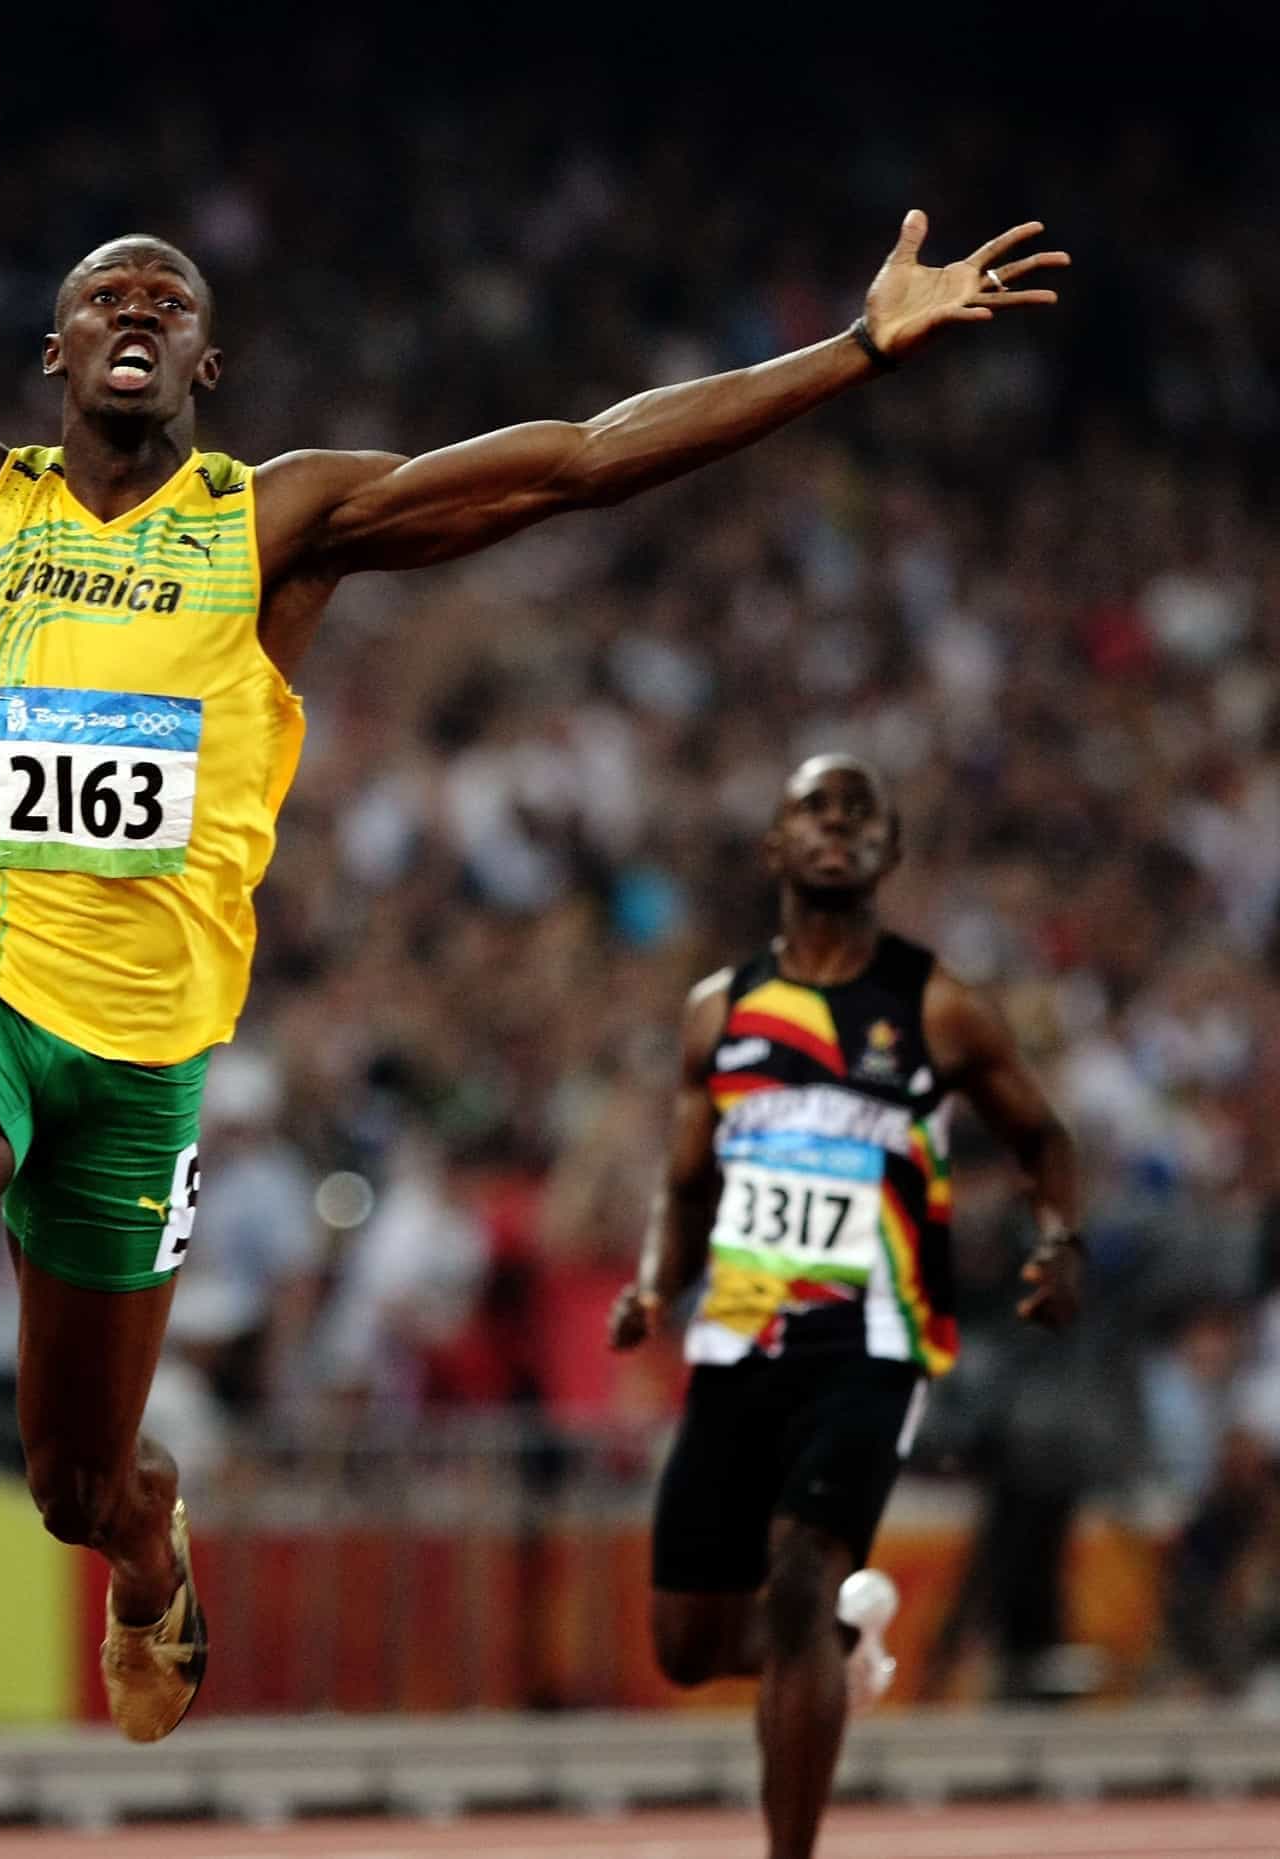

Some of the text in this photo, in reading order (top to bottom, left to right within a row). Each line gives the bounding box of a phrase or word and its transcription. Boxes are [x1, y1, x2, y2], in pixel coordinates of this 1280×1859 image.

[87, 713, 128, 728] 2008
[10, 755, 164, 840] 2163
[740, 1180, 852, 1248] 3317
